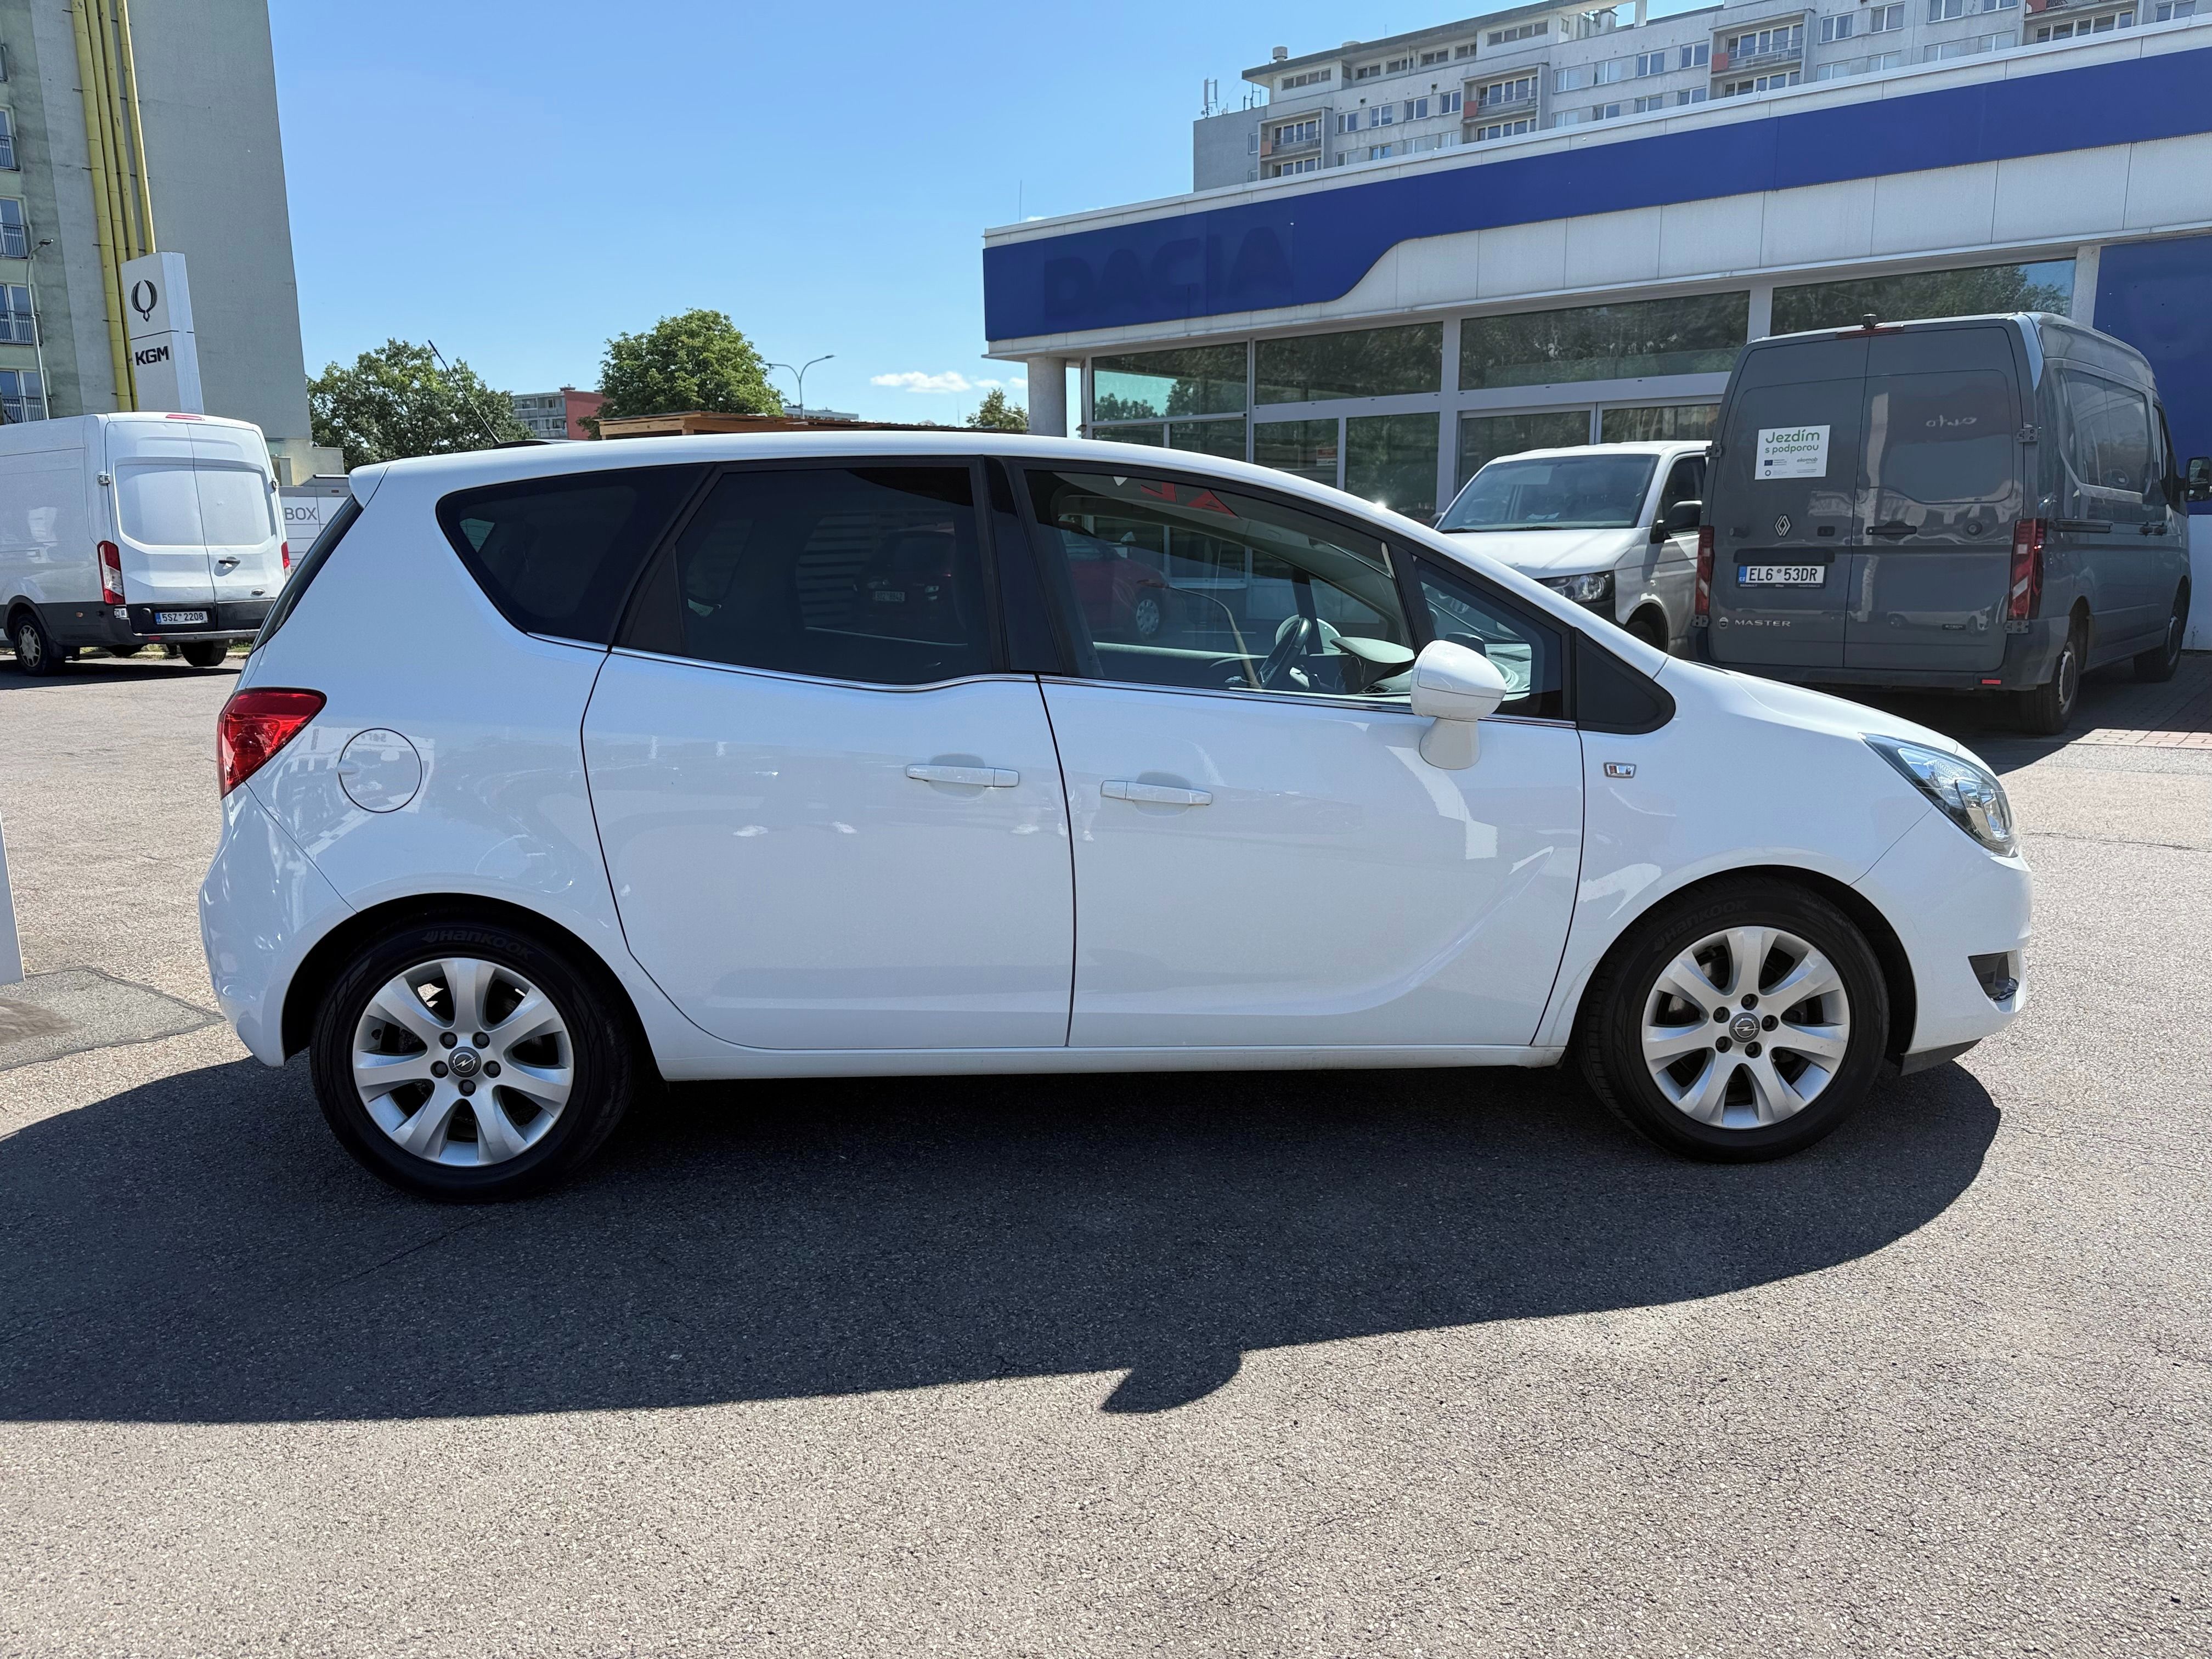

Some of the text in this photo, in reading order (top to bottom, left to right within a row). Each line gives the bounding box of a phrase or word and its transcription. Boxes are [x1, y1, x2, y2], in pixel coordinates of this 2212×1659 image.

[135, 346, 170, 366] KGM
[1765, 428, 1820, 444] Jezdím
[1772, 443, 1819, 455] podporou
[284, 507, 318, 521] BOX
[1749, 567, 1818, 582] EL6 53DR
[162, 613, 178, 622] 5SZ
[184, 612, 204, 621] 2208
